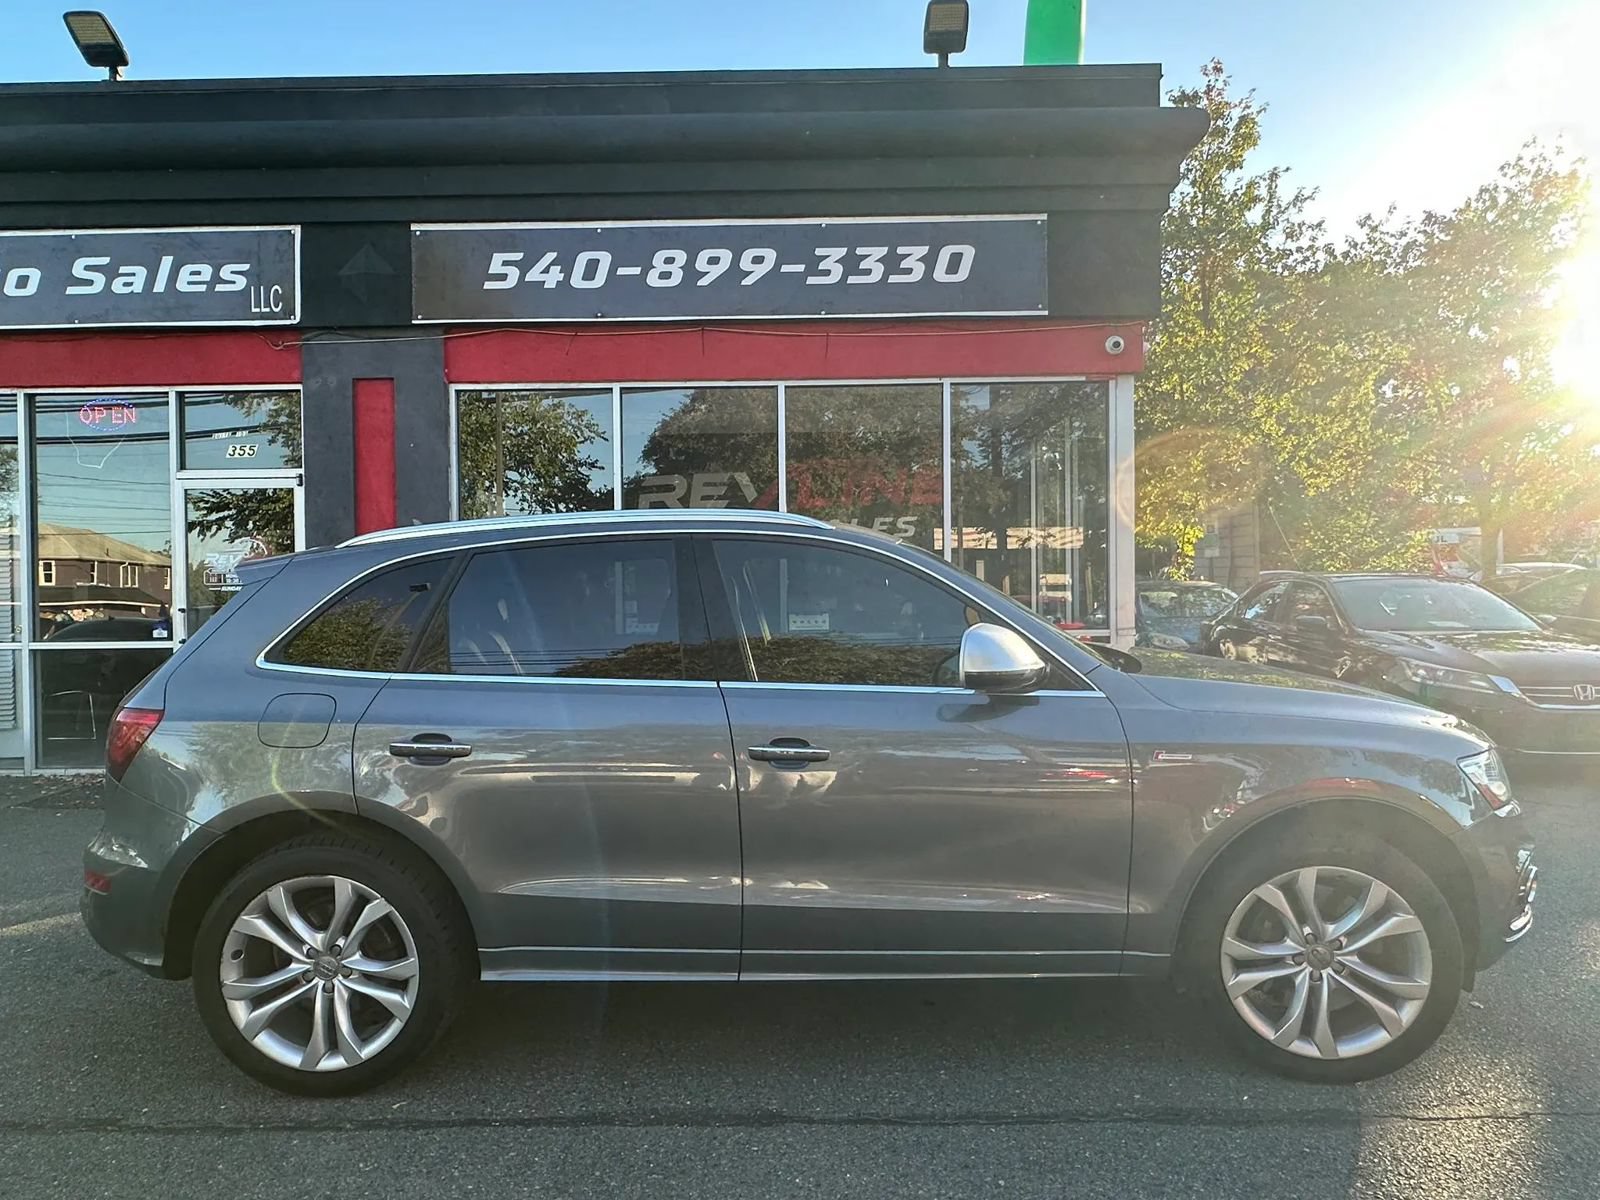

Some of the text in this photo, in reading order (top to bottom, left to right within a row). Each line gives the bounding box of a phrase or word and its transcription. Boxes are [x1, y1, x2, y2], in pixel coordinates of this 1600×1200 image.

[482, 244, 976, 290] 540-899-3330
[65, 255, 251, 295] Sales
[251, 285, 283, 313] LLC
[80, 406, 136, 424] OPEN
[228, 445, 257, 457] 355
